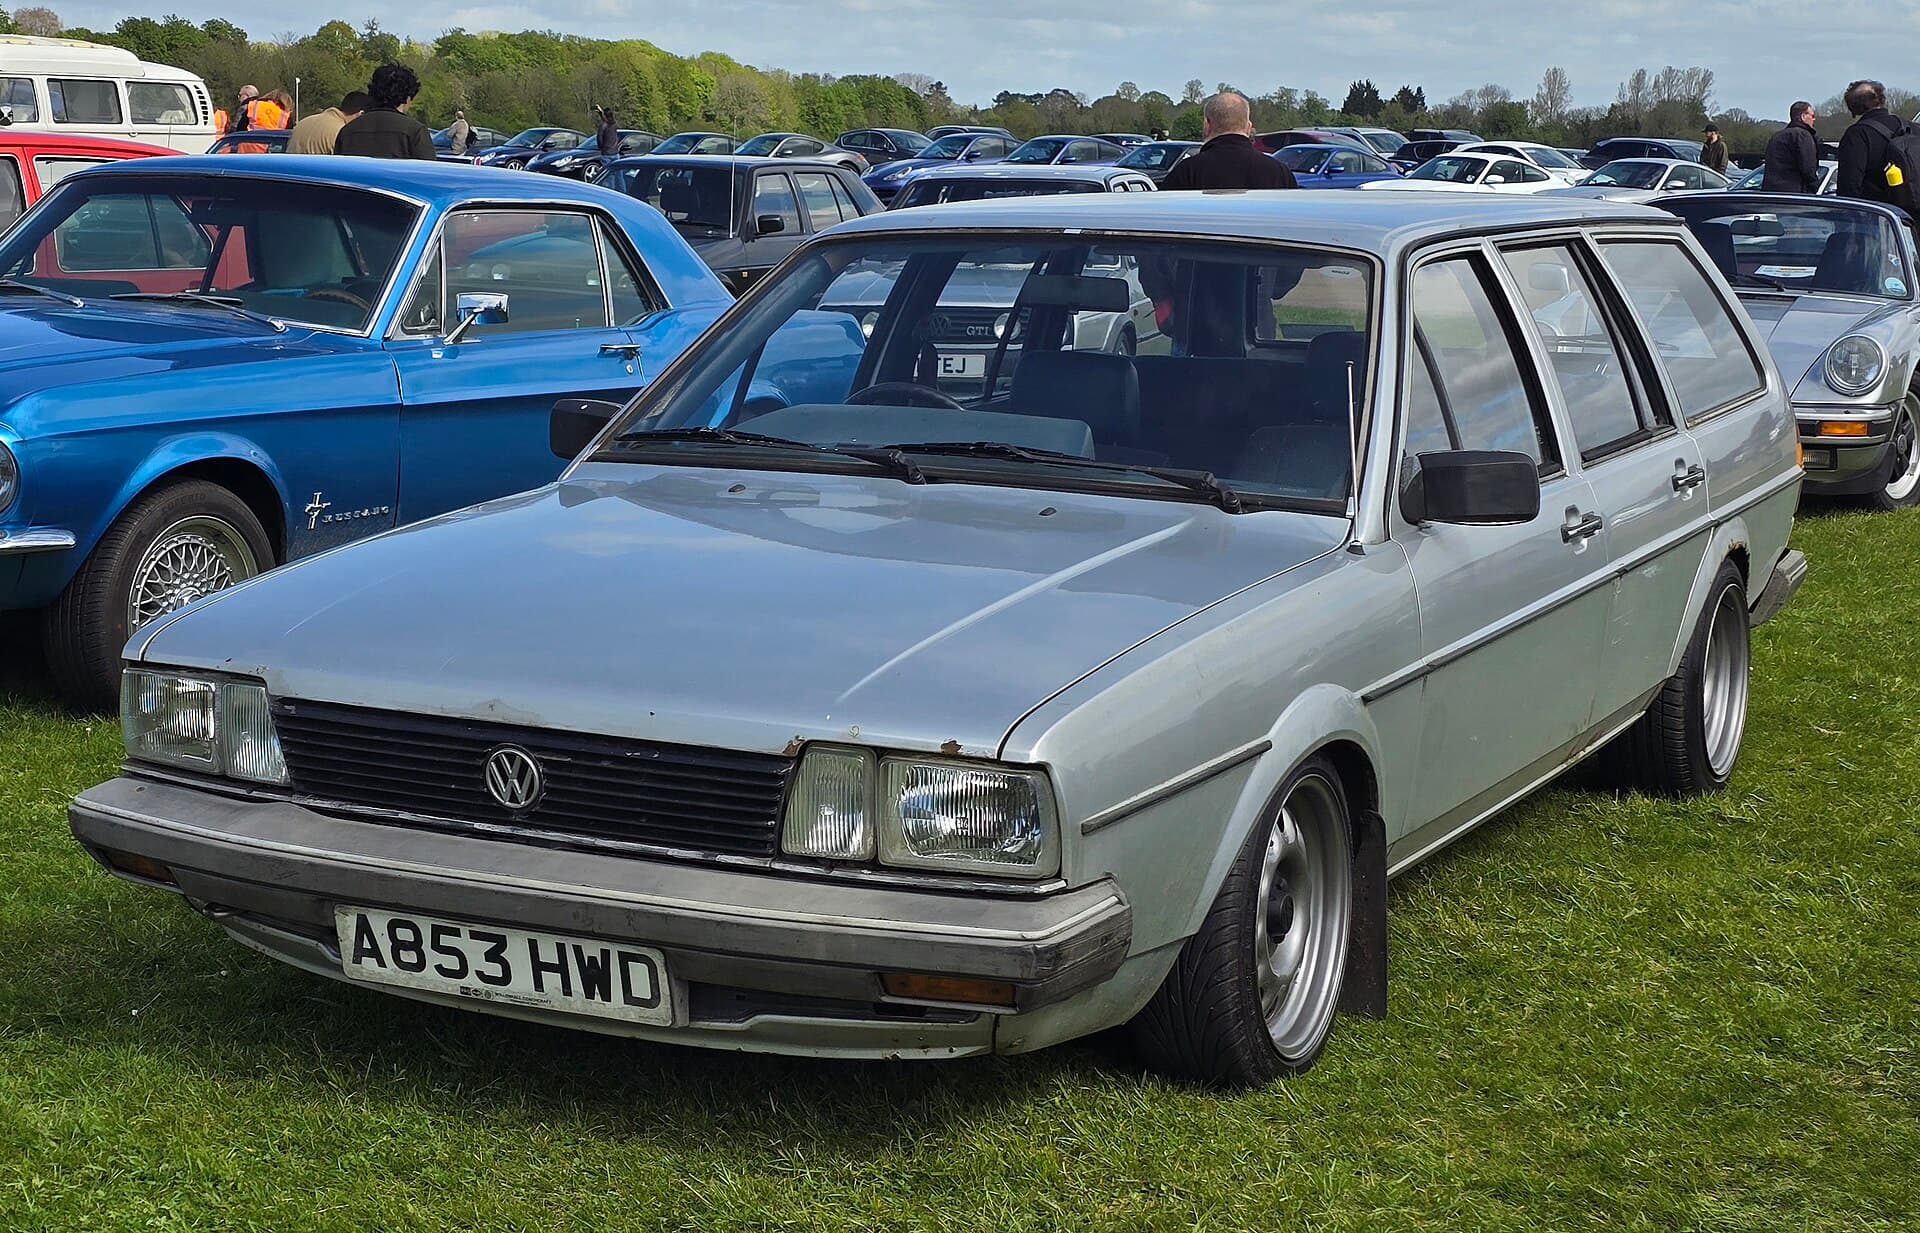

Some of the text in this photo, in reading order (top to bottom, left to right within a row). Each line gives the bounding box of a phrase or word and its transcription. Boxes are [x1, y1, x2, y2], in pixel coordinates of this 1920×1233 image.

[966, 325, 990, 336] GTI
[938, 357, 966, 373] EJ
[486, 750, 539, 807] VW
[352, 914, 659, 1009] A853 HWD
